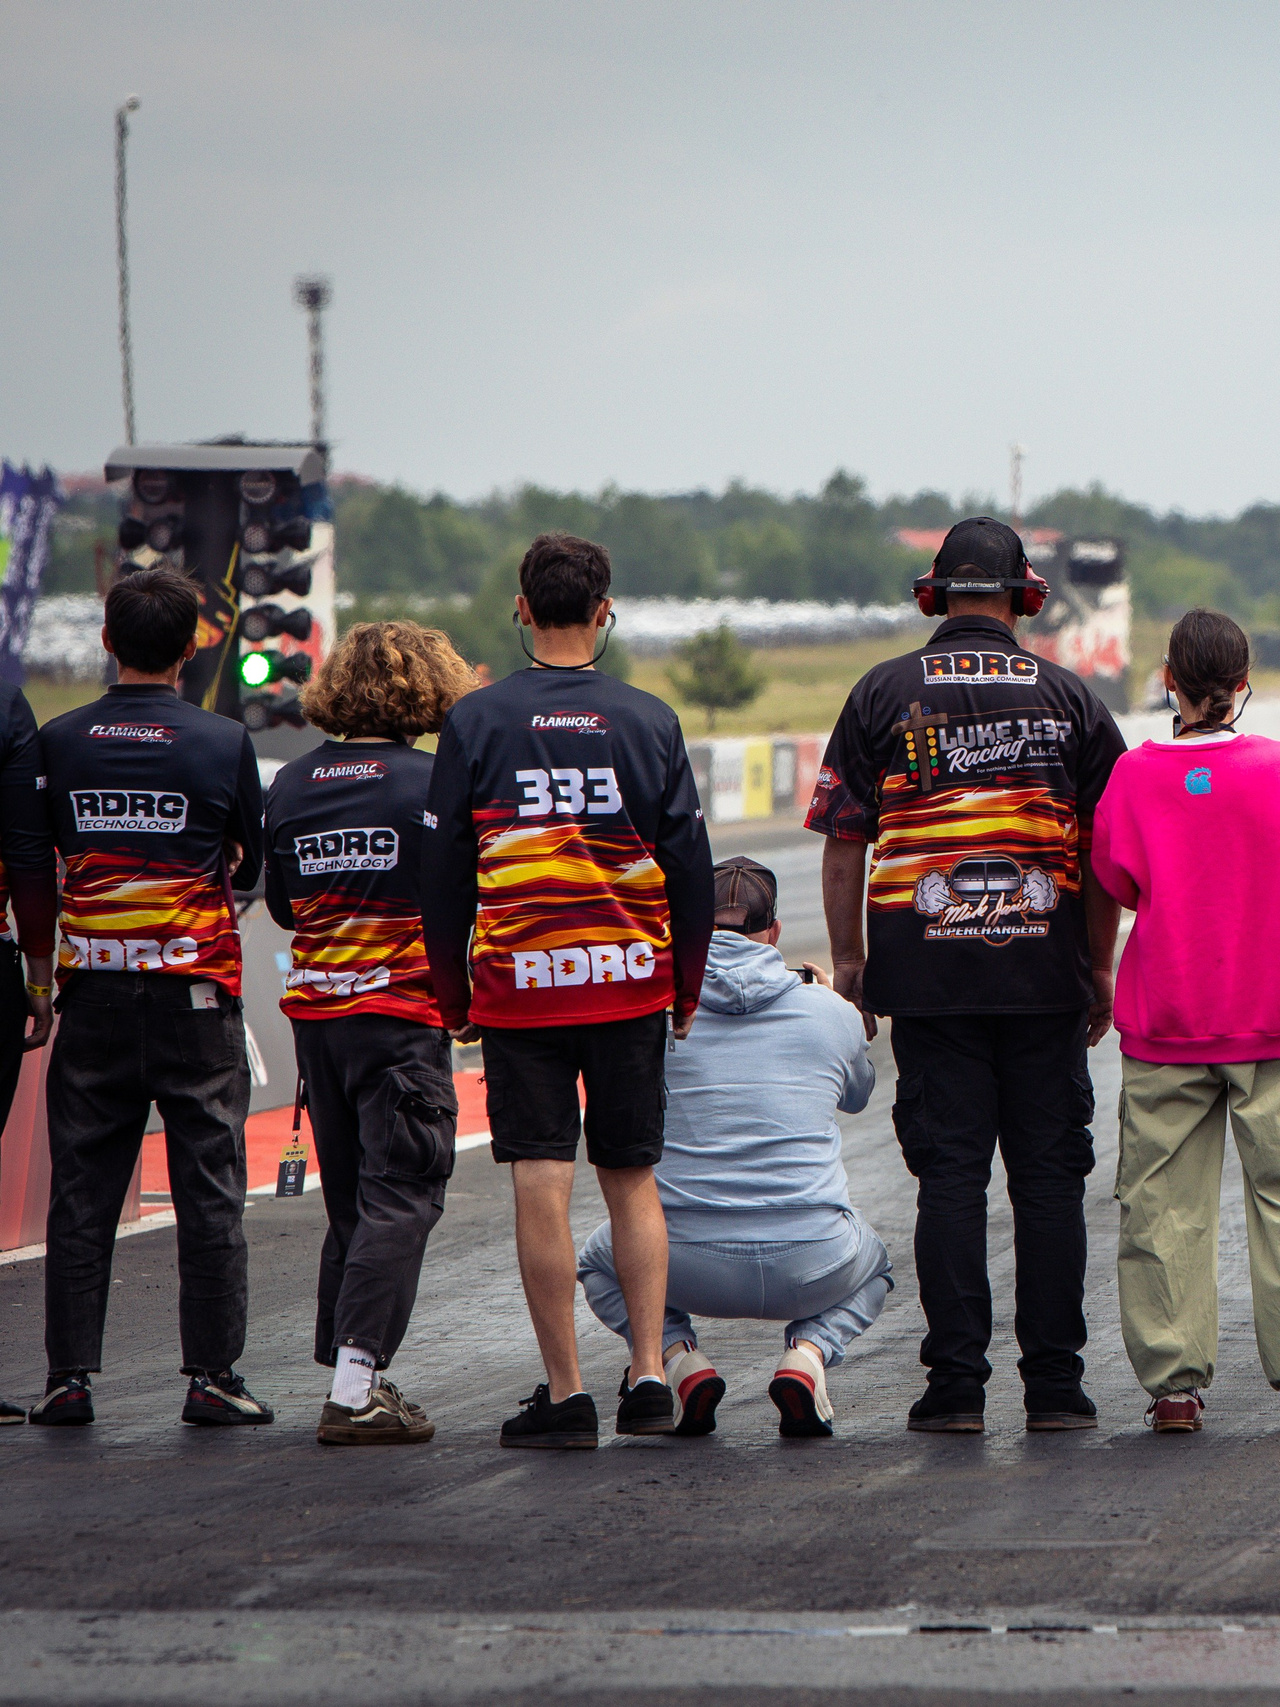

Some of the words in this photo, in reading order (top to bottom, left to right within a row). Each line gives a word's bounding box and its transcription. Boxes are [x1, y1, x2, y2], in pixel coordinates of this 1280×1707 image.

[921, 652, 1037, 677] RDRC
[996, 676, 1036, 684] COMMUNITY
[531, 715, 599, 728] FLAMHOLC
[89, 725, 165, 738] FLAMHOLC
[938, 721, 1013, 751] LUKE
[946, 738, 1026, 773] Racing
[312, 763, 378, 779] FLAMHOLC
[986, 765, 1007, 773] nothing
[516, 768, 623, 817] 333
[73, 791, 185, 819] RDRC
[78, 819, 182, 831] TECHNOLOGY
[297, 830, 395, 861] RDRC
[302, 858, 394, 873] TECHNOLOGY
[927, 924, 1046, 937] SUPERCHARGERS
[511, 941, 656, 989] RDRC
